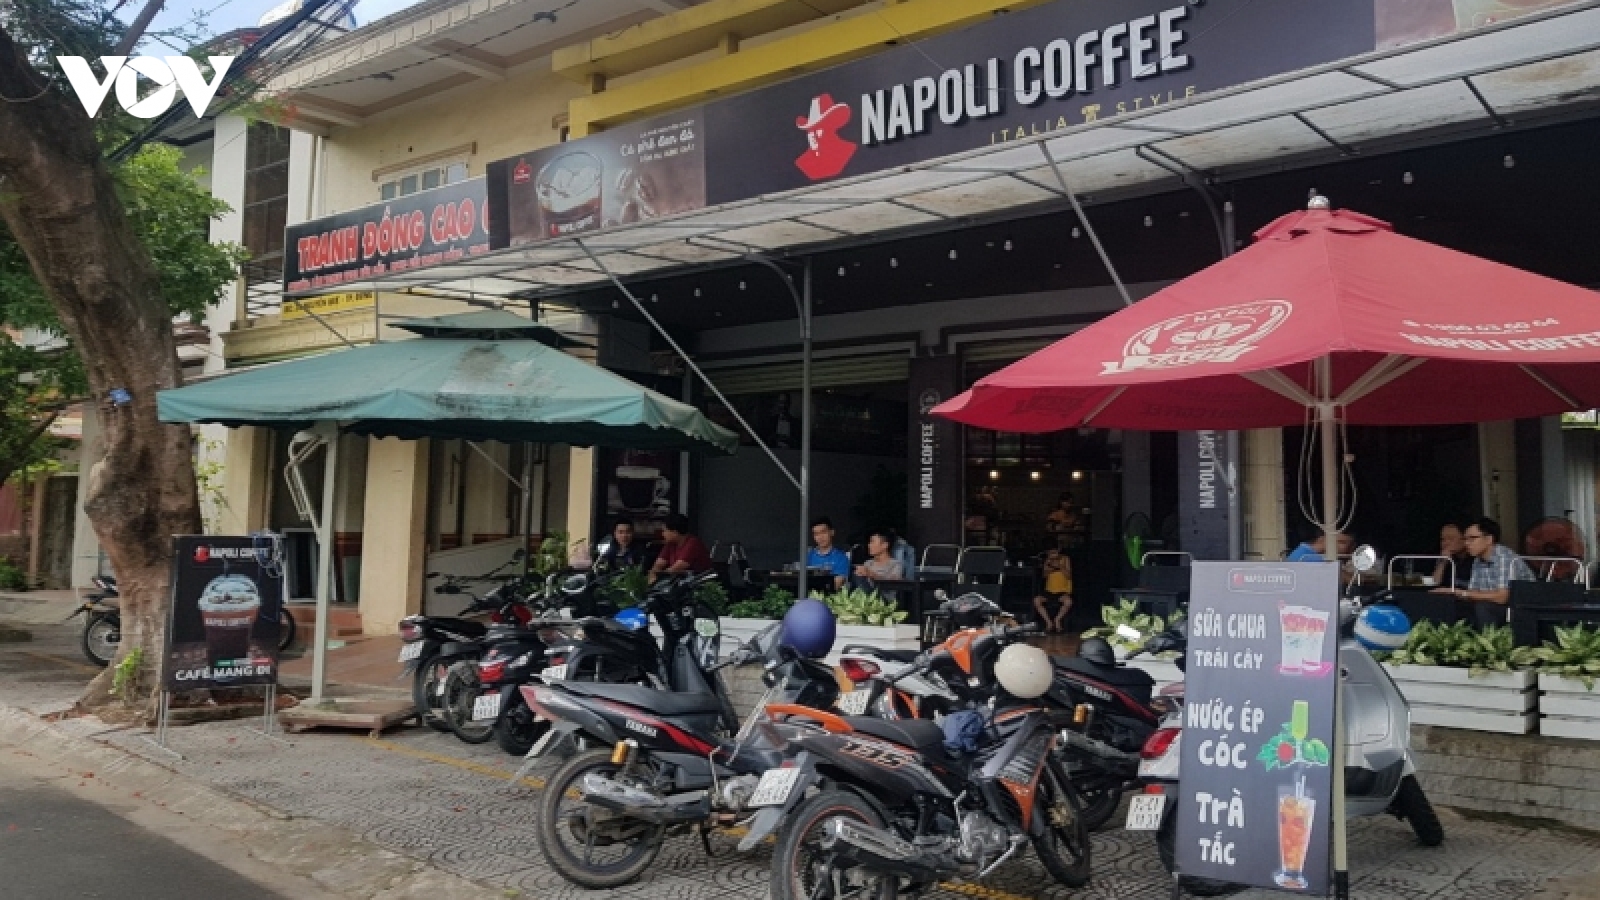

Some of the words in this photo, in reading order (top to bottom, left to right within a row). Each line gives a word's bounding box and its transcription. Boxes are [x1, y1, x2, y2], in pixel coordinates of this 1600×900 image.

[861, 57, 999, 146] NAPOLI
[1013, 5, 1190, 106] COFFEE
[991, 115, 1066, 147] ITALIA
[298, 225, 359, 273] TRANH
[430, 197, 476, 246] CAO
[1399, 331, 1512, 351] NAPOLI
[1508, 331, 1600, 351] COFFE
[921, 424, 934, 464] COFFEE
[921, 468, 932, 508] NAPOLI
[1199, 461, 1215, 509] NAPOLI
[1193, 606, 1222, 638] SỮA
[1227, 612, 1266, 639] CHUA
[213, 664, 253, 678] MANG
[1193, 646, 1229, 670] TRÁI
[1233, 647, 1263, 671] CÂY
[1187, 697, 1235, 732] NƯỚC
[1240, 698, 1265, 734] ÉP
[1198, 733, 1248, 770] CÓC
